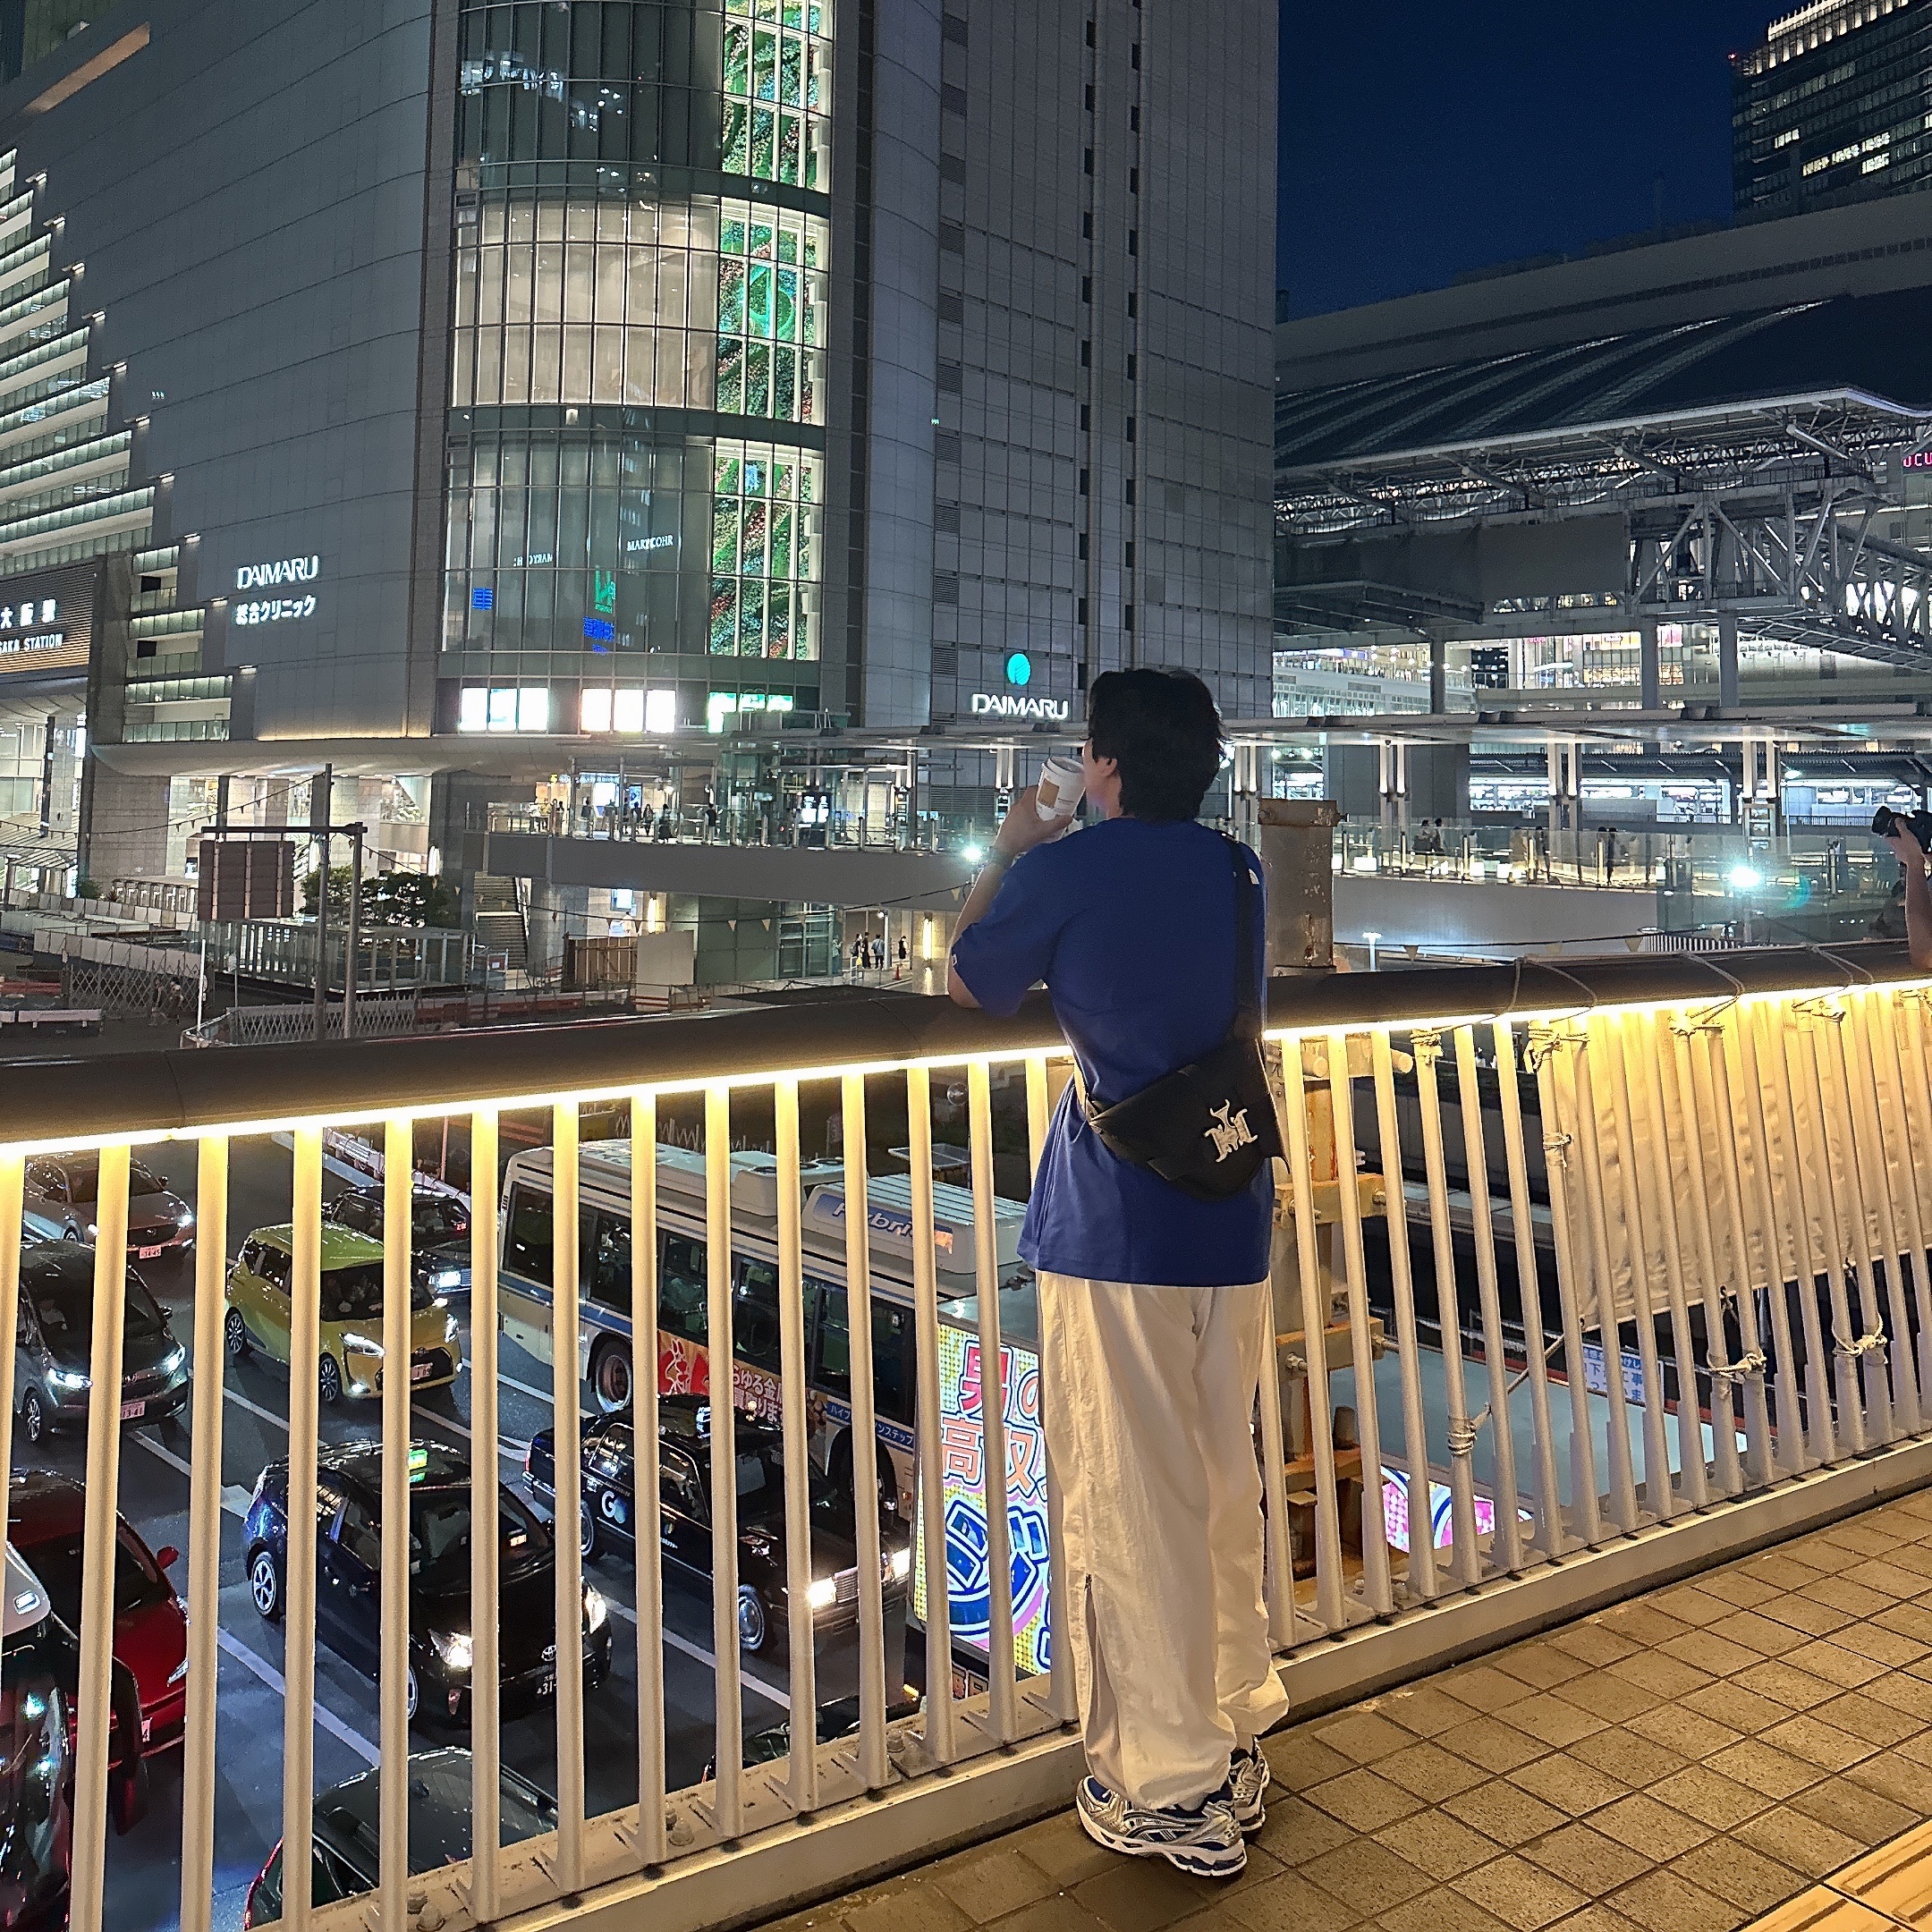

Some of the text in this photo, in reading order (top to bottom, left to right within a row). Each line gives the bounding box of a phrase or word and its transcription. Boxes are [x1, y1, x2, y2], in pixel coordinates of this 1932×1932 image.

[236, 555, 319, 590] DAIMARU
[235, 594, 317, 625] 総合クリニック
[23, 632, 64, 651] STATION
[971, 693, 1069, 719] DAIMARU
